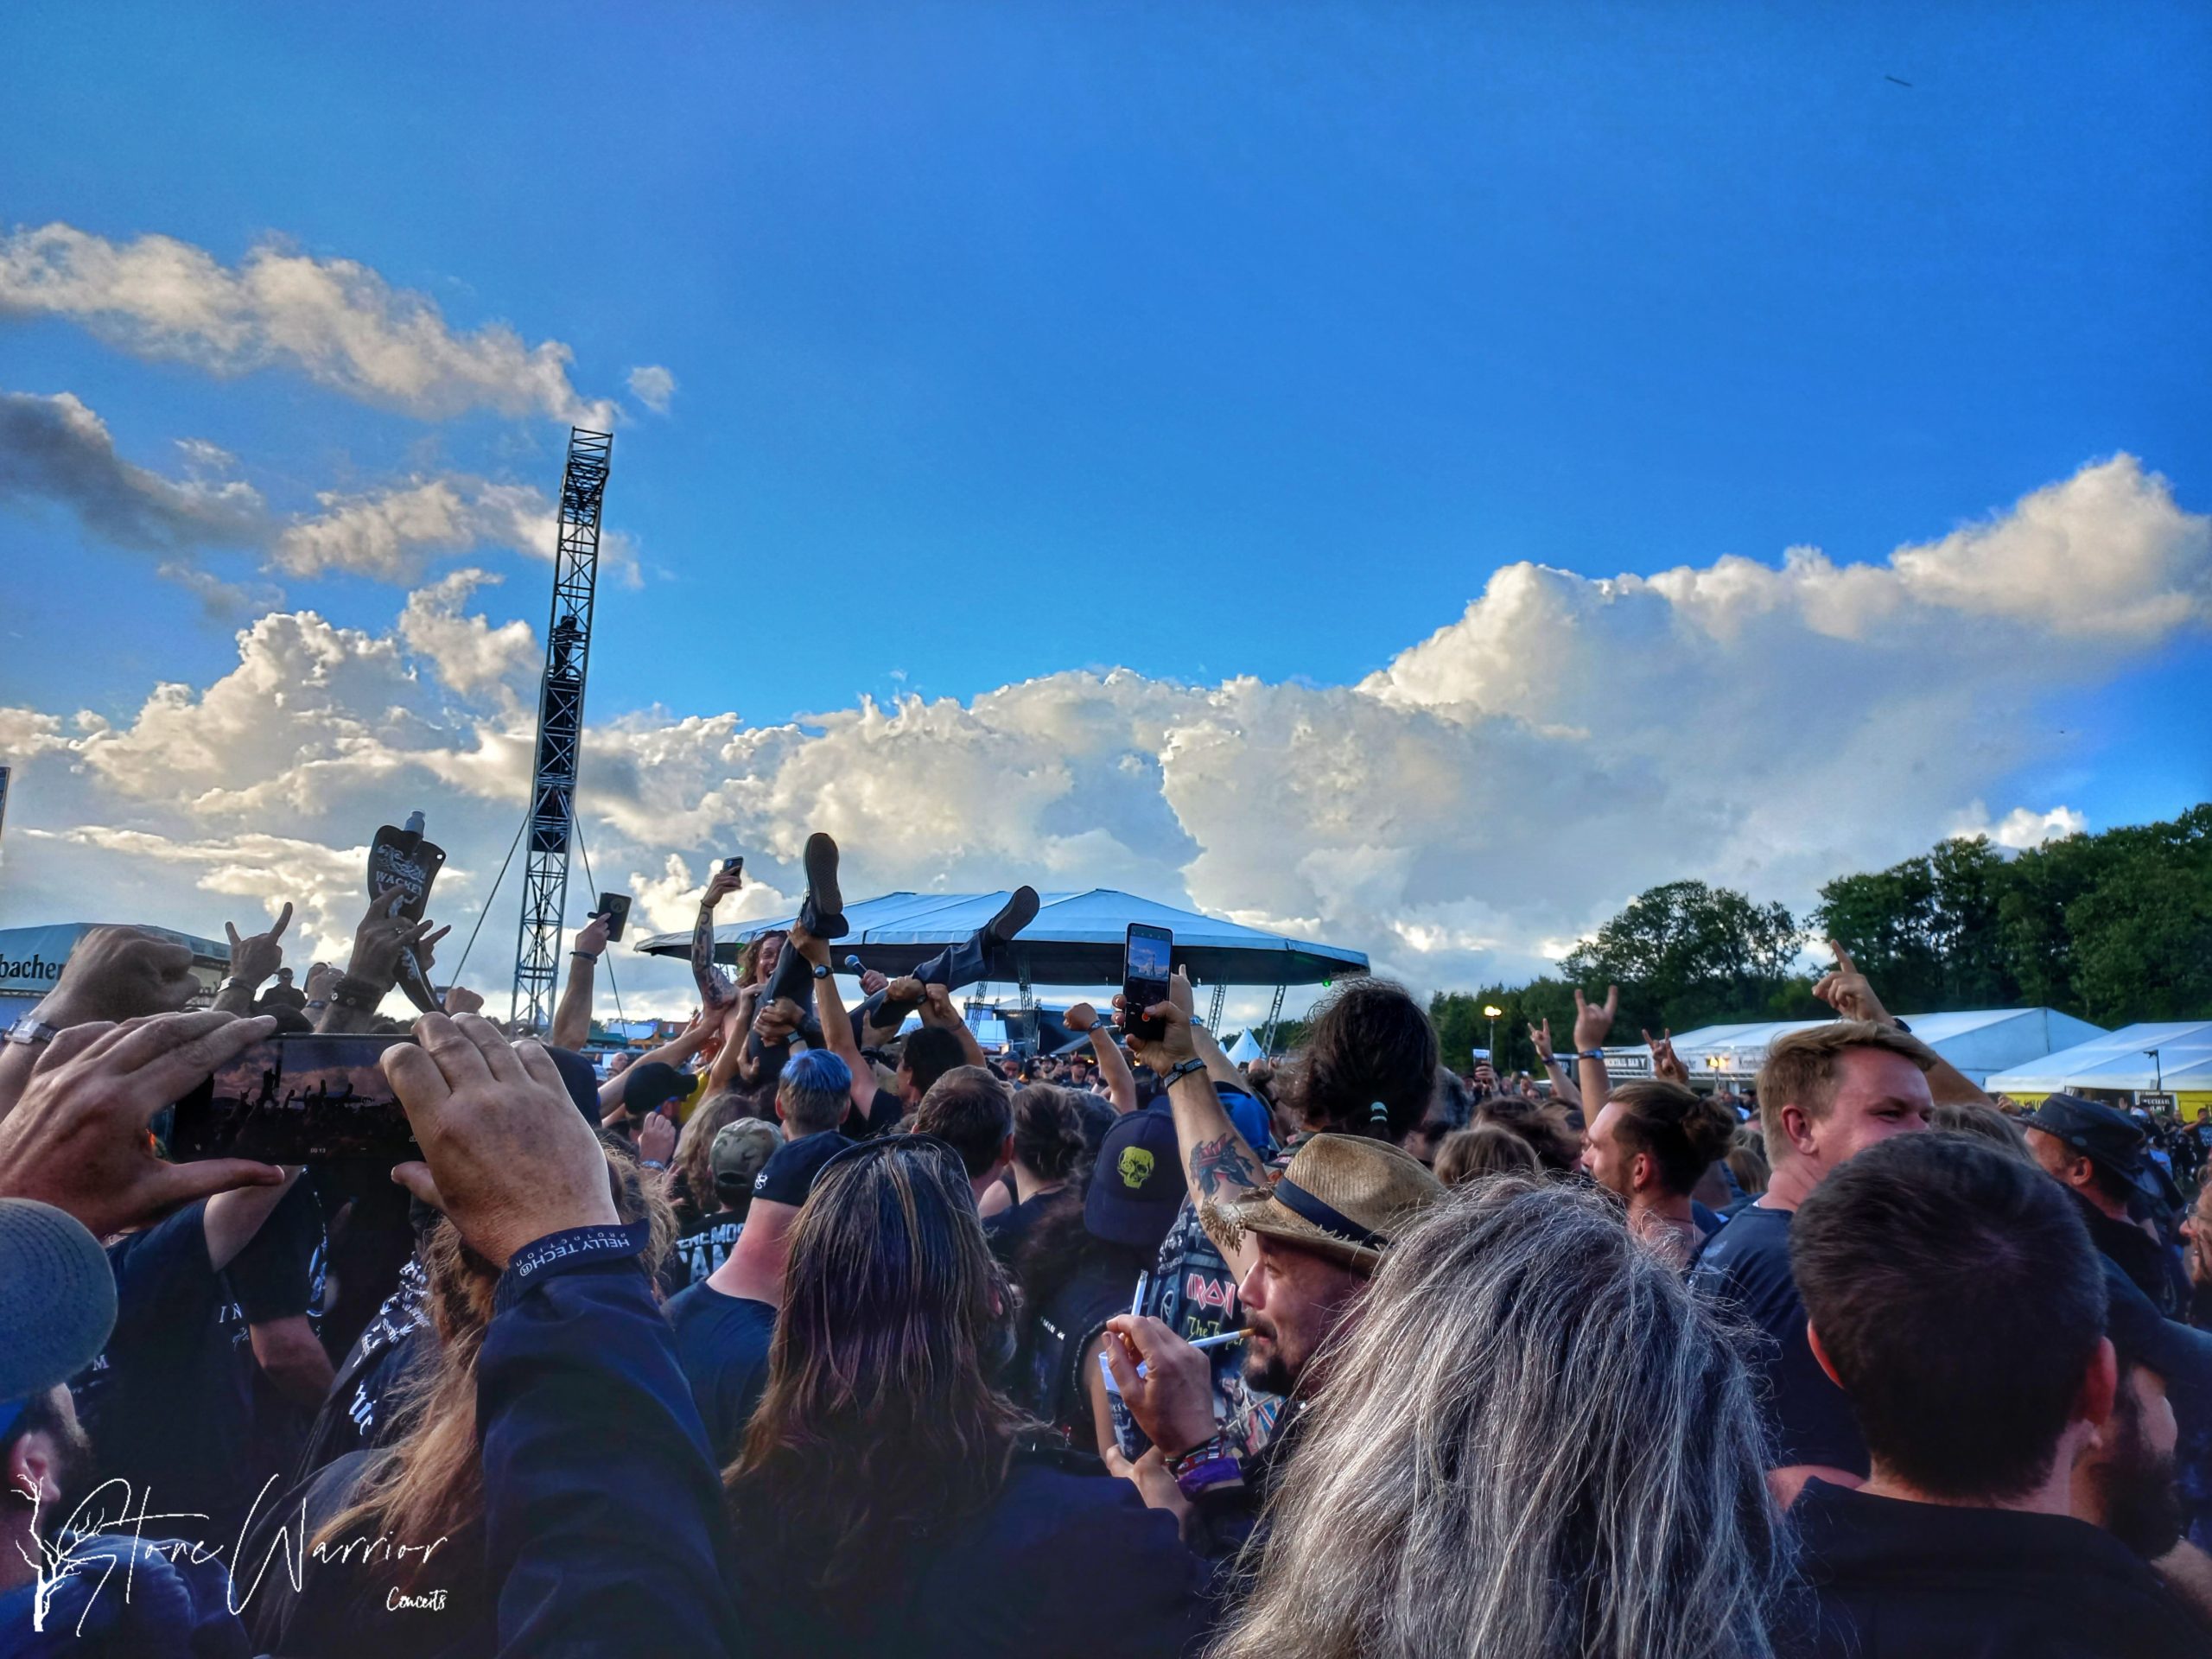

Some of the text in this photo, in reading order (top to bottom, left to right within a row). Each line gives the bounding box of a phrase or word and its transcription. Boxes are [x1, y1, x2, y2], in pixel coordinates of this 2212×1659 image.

[582, 1238, 630, 1251] HELLY
[1186, 1273, 1236, 1320] IRON
[1186, 1316, 1209, 1342] The
